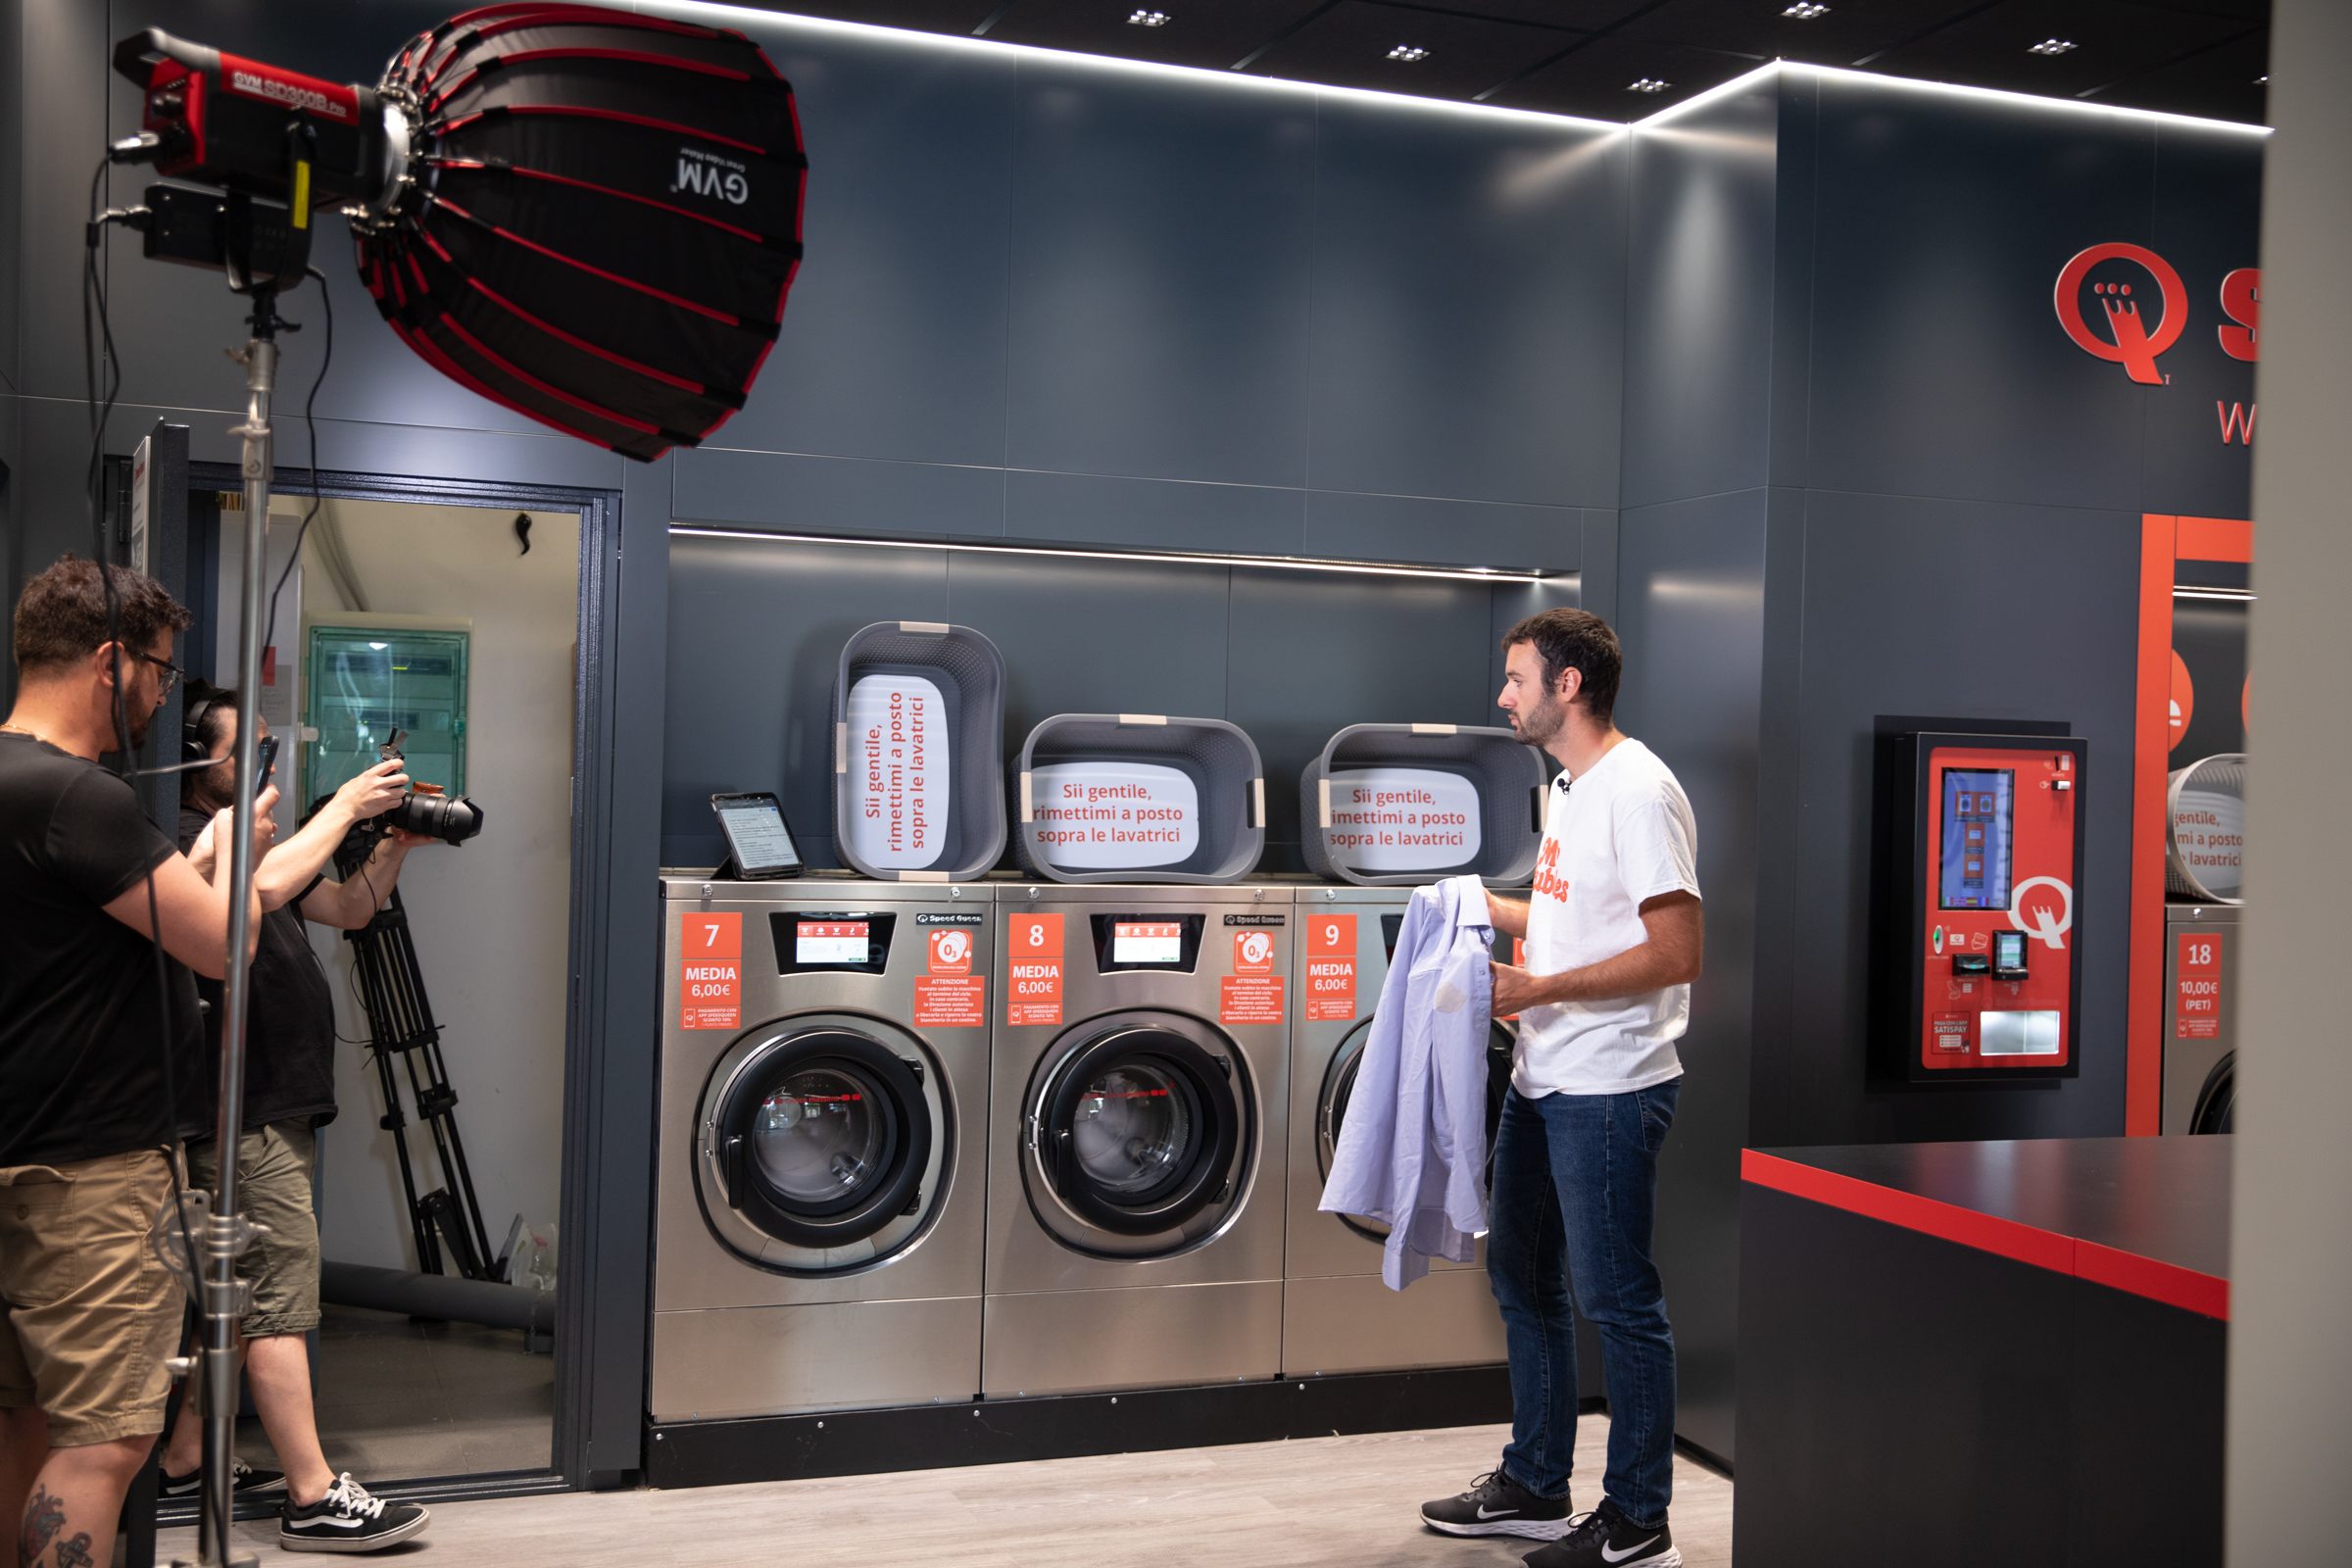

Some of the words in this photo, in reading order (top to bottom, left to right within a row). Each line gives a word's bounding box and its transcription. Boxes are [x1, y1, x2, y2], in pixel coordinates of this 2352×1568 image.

[233, 72, 262, 89] GVM
[329, 102, 346, 115] Pro
[678, 159, 748, 204] GVM
[889, 692, 906, 742] posto
[909, 697, 924, 770] lavatrici
[865, 724, 885, 793] gentile,
[891, 749, 902, 759] a
[909, 777, 924, 792] le
[1063, 784, 1083, 798] Sii
[1088, 784, 1152, 802] gentile,
[1352, 789, 1371, 803] Sii
[1376, 789, 1436, 807] gentile,
[865, 798, 880, 818] Sii
[888, 764, 902, 852] rimettimi
[1033, 806, 1116, 820] rimettimi
[1121, 808, 1131, 820] a
[1137, 807, 1183, 824] posto
[912, 799, 928, 849] sopra
[1332, 810, 1402, 824] imettimi
[1407, 813, 1416, 824] a
[1422, 811, 1465, 828] posto
[1037, 830, 1085, 846] sopra
[1091, 827, 1106, 842] le
[1111, 827, 1180, 842] lavatrici
[1379, 831, 1393, 846] le
[1398, 831, 1463, 846] lavatrici
[2197, 834, 2205, 846] a
[705, 924, 720, 947] 7
[1029, 924, 1045, 947] 8
[1325, 924, 1340, 946] 9
[2188, 944, 2212, 965] 18
[685, 967, 737, 981] MEDIA
[1012, 965, 1058, 978] MEDIA
[1309, 963, 1352, 976] MEDIA
[691, 984, 730, 998] 6,00€
[1018, 981, 1054, 995] 6,00€
[1314, 979, 1348, 992] 6,00€
[2180, 981, 2218, 996] 10,00€
[2185, 999, 2211, 1011] (PET)
